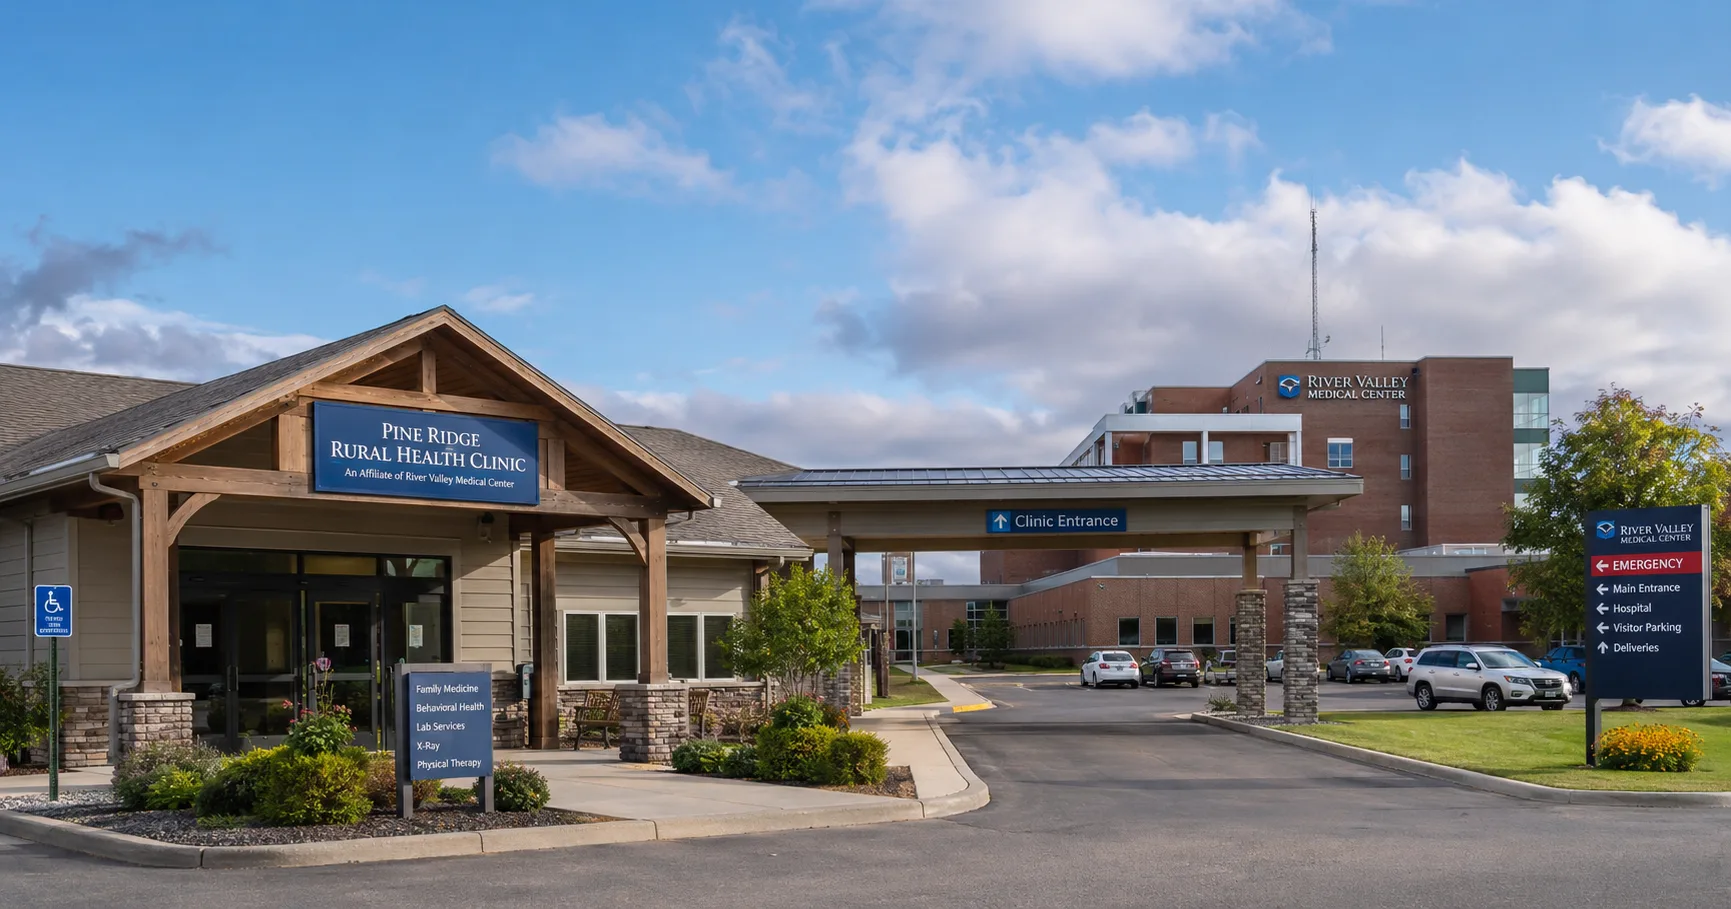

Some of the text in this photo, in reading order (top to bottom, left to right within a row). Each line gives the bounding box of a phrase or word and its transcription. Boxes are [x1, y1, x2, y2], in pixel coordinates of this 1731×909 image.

[1308, 375, 1408, 388] RIVER VALLEY
[1308, 390, 1405, 399] MEDICAL CENTER
[382, 422, 480, 448] PINE RIDGE
[331, 440, 526, 472] RURAL HEALTH CLINIC
[345, 468, 515, 488] An Affiliate of River Valley Medical Center
[1015, 514, 1118, 528] Clinic Entrance
[1620, 523, 1694, 535] RIVER VALLEY
[1620, 534, 1692, 544] MEDICAL CENTER
[1613, 558, 1683, 571] EMERGENCY
[1613, 583, 1681, 594] Main Entrance
[1613, 603, 1652, 615] Hospital
[1613, 622, 1682, 634] Visitor Parking
[1614, 643, 1659, 653] Deliveries
[416, 684, 479, 695] Family Medicine
[416, 702, 484, 713] Behavioral Health
[416, 722, 465, 731] Lab Services
[417, 742, 440, 752] X-Ray
[417, 759, 482, 771] Physical Therapy
